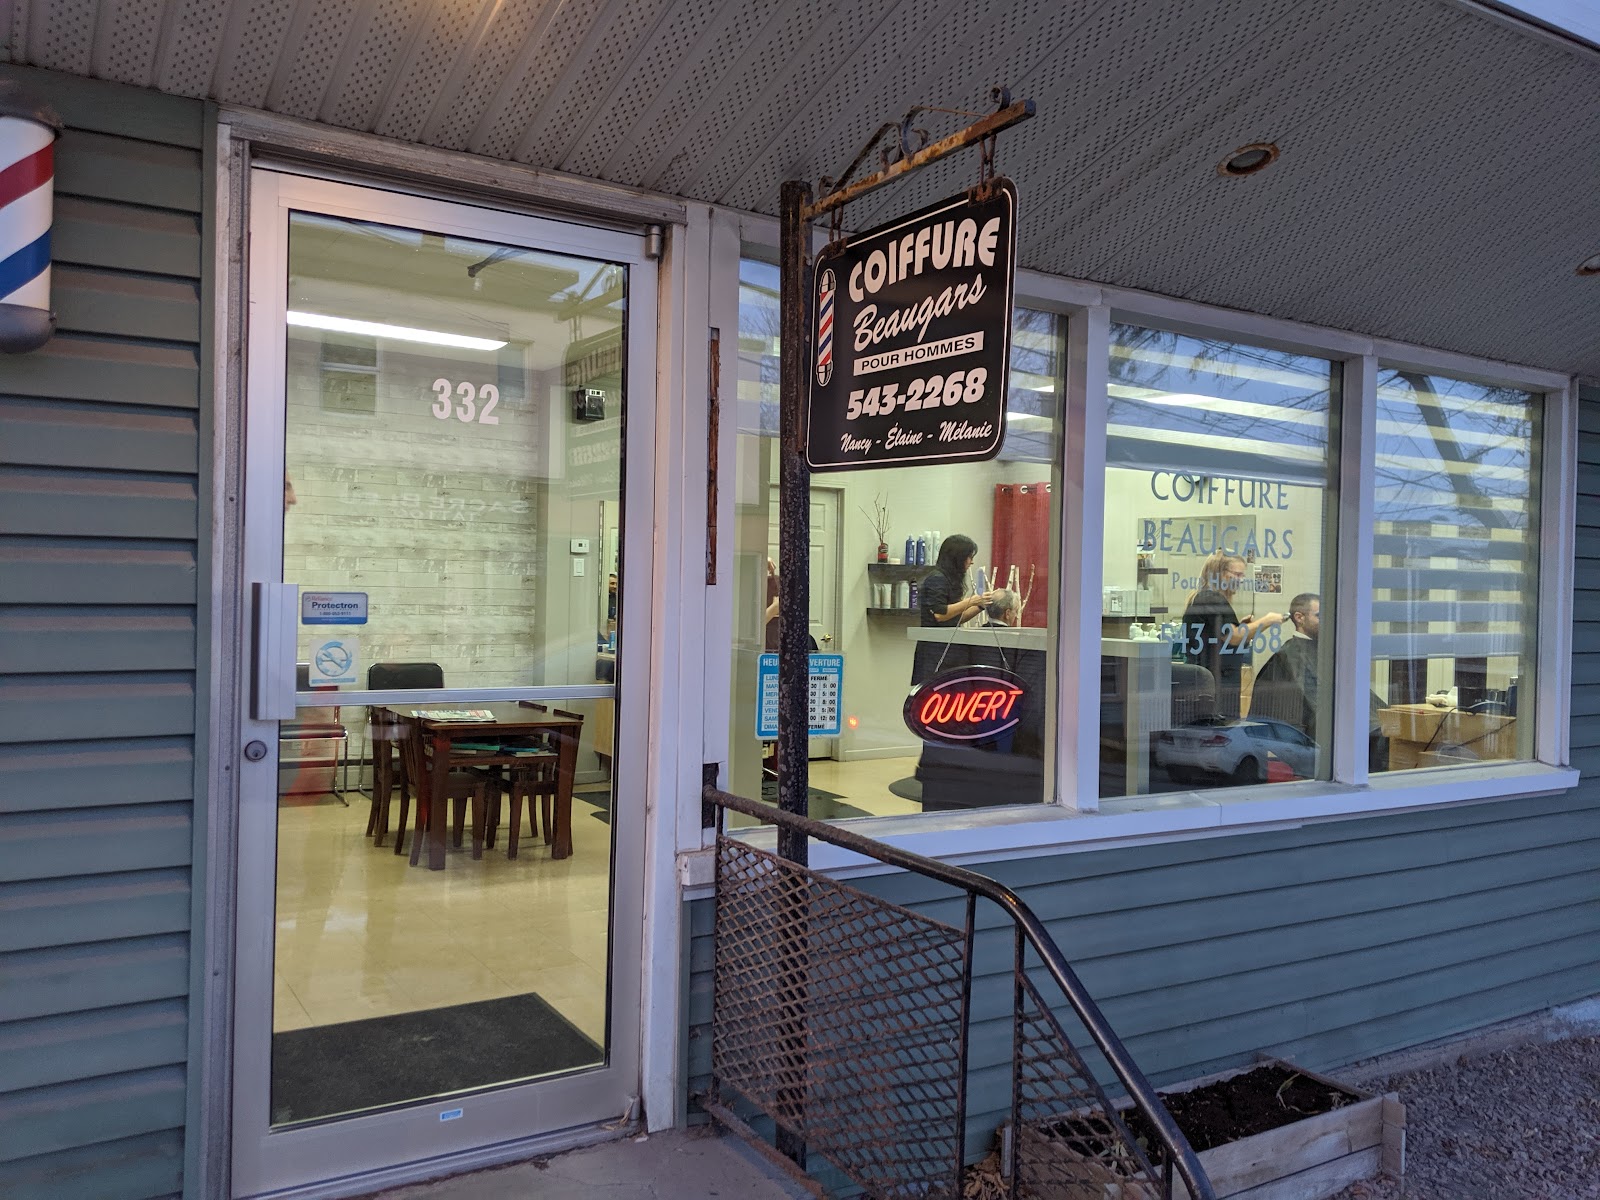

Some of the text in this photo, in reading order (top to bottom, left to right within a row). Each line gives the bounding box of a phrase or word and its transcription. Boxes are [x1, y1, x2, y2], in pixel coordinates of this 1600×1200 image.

[848, 216, 1001, 303] COIFFURE
[853, 273, 988, 353] Beaugars
[861, 336, 976, 371] POUR HOMMES
[432, 378, 500, 425] 332
[846, 367, 988, 420] 543-2268
[840, 432, 873, 455] Nancy
[884, 422, 923, 450] Élaine
[938, 420, 993, 443] Mélanie
[1151, 469, 1290, 510] COIFFURE
[1142, 518, 1294, 559] BEAUGARS
[1160, 622, 1282, 656] 543-2268
[763, 658, 841, 667] HEU VERTURE
[920, 690, 1024, 725] OUVERT
